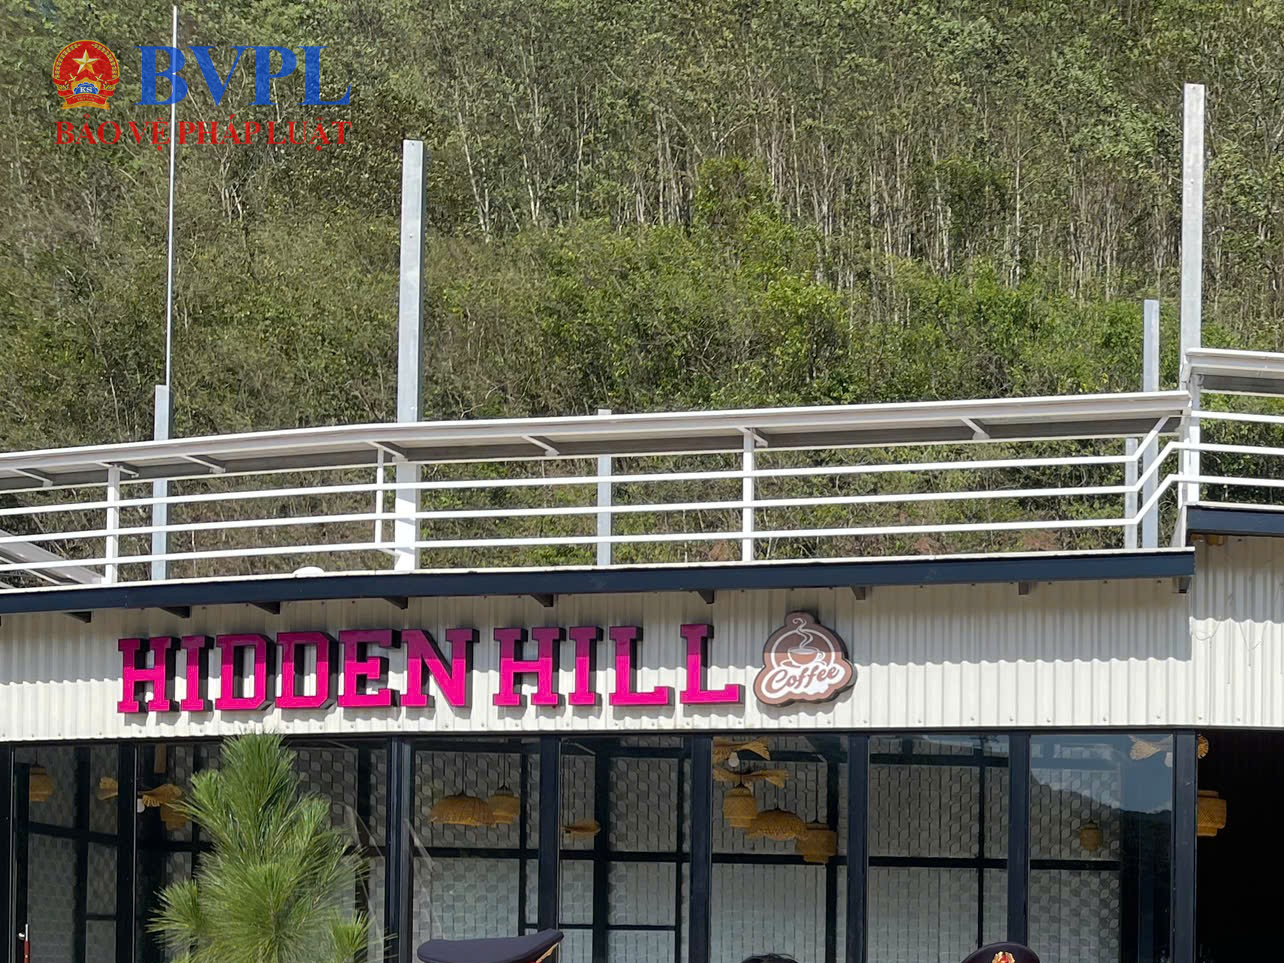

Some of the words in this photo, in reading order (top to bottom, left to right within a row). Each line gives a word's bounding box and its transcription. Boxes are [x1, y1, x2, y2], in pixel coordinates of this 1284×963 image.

[117, 627, 477, 713] HIDDEN
[493, 623, 742, 707] HILL
[765, 664, 840, 694] Coffee
